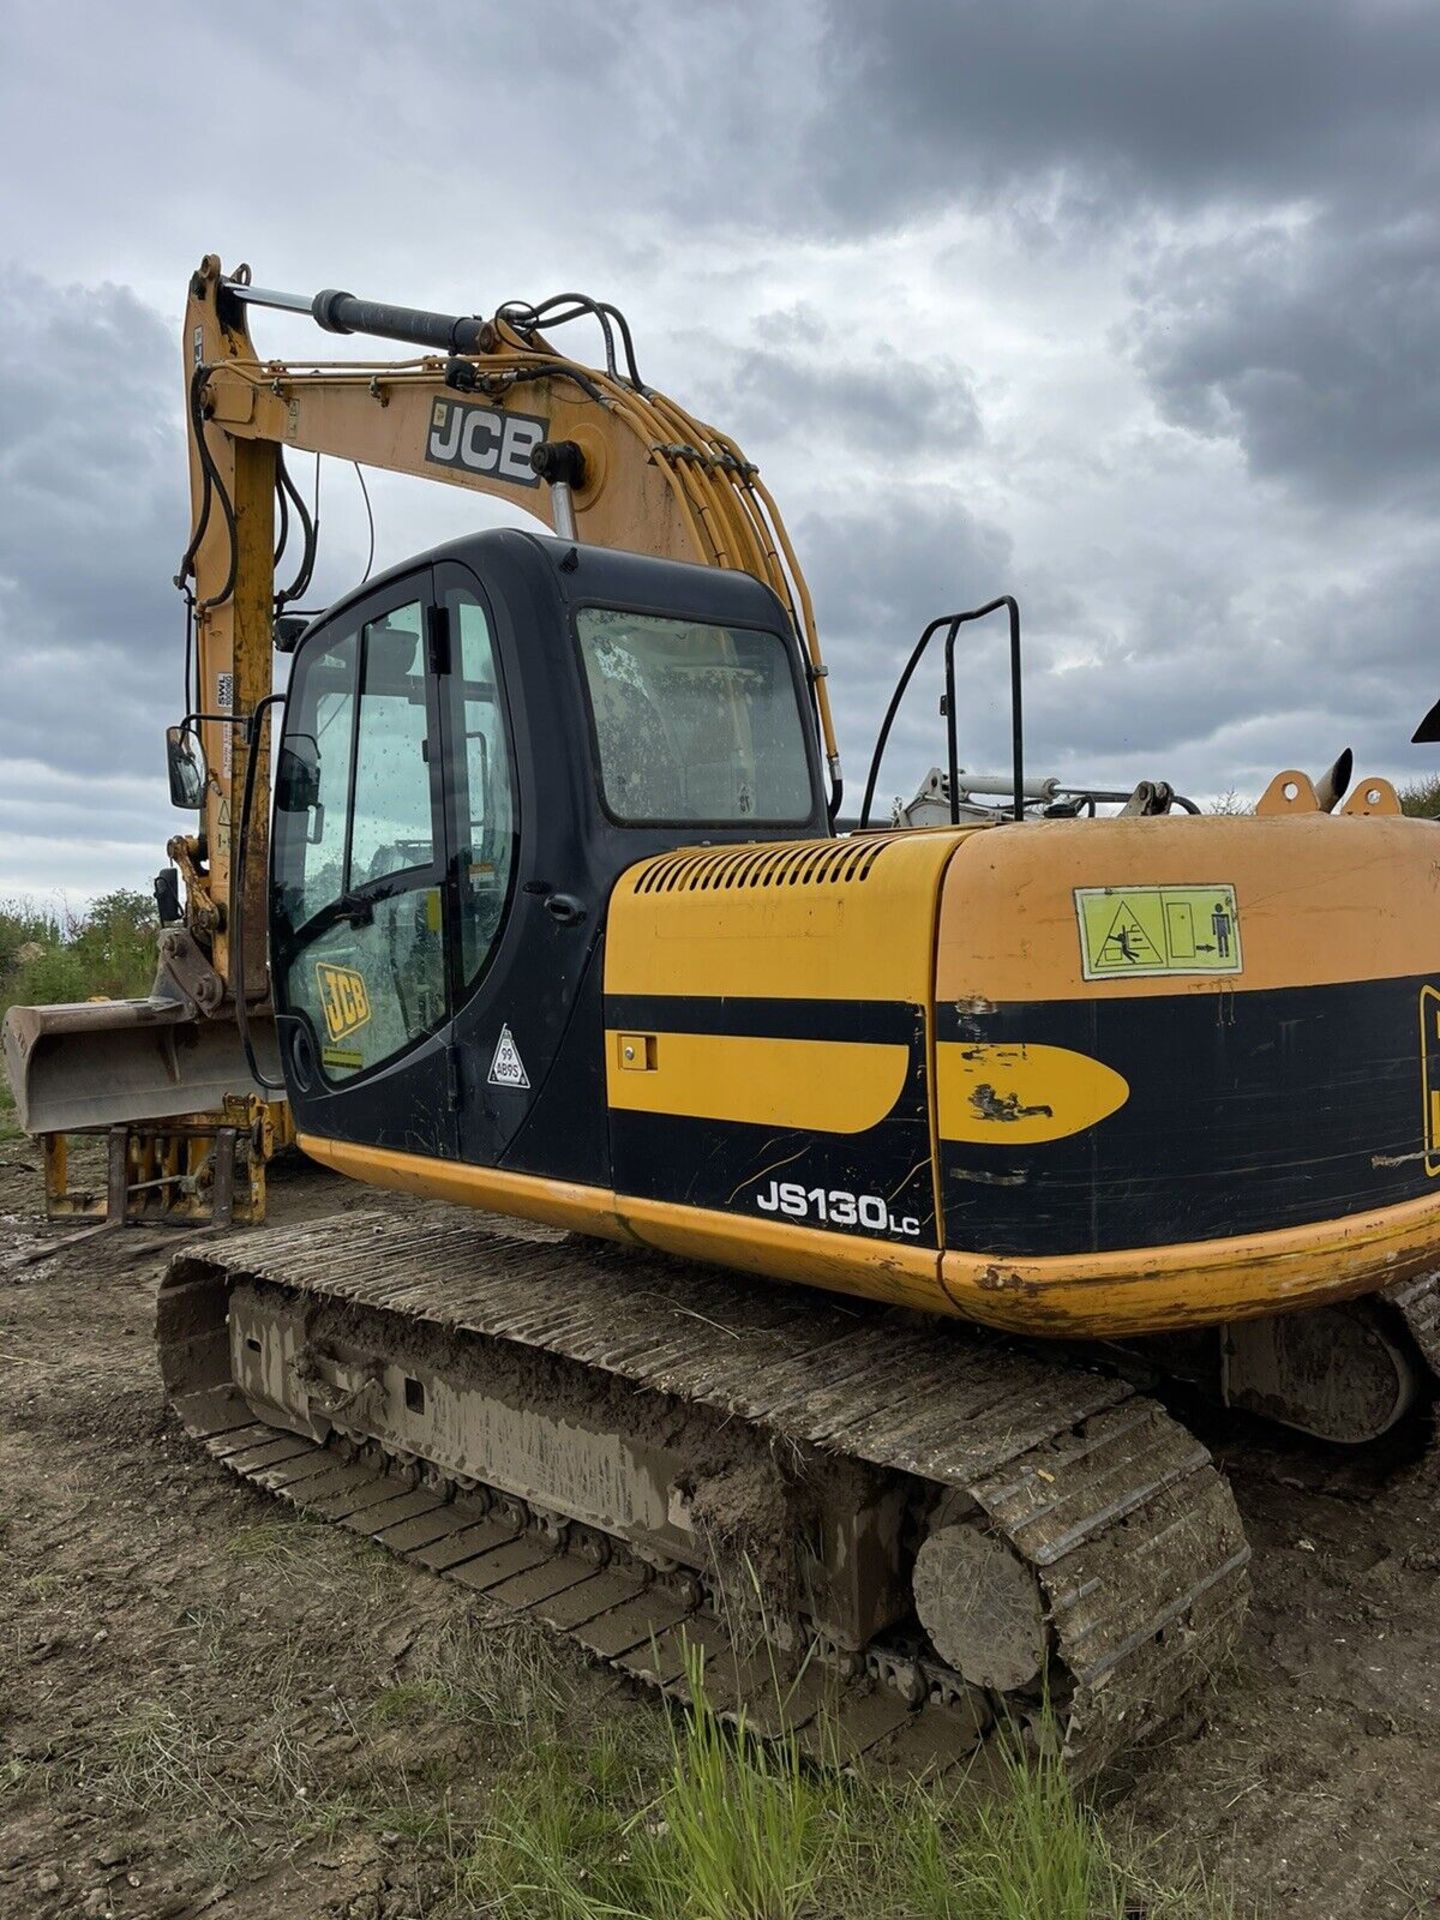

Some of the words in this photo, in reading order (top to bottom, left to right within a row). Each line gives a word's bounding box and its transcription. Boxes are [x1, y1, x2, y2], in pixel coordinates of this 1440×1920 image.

[430, 406, 543, 480] JCB
[217, 676, 225, 705] SWL
[325, 971, 367, 1032] JCB
[501, 1048, 513, 1061] 99
